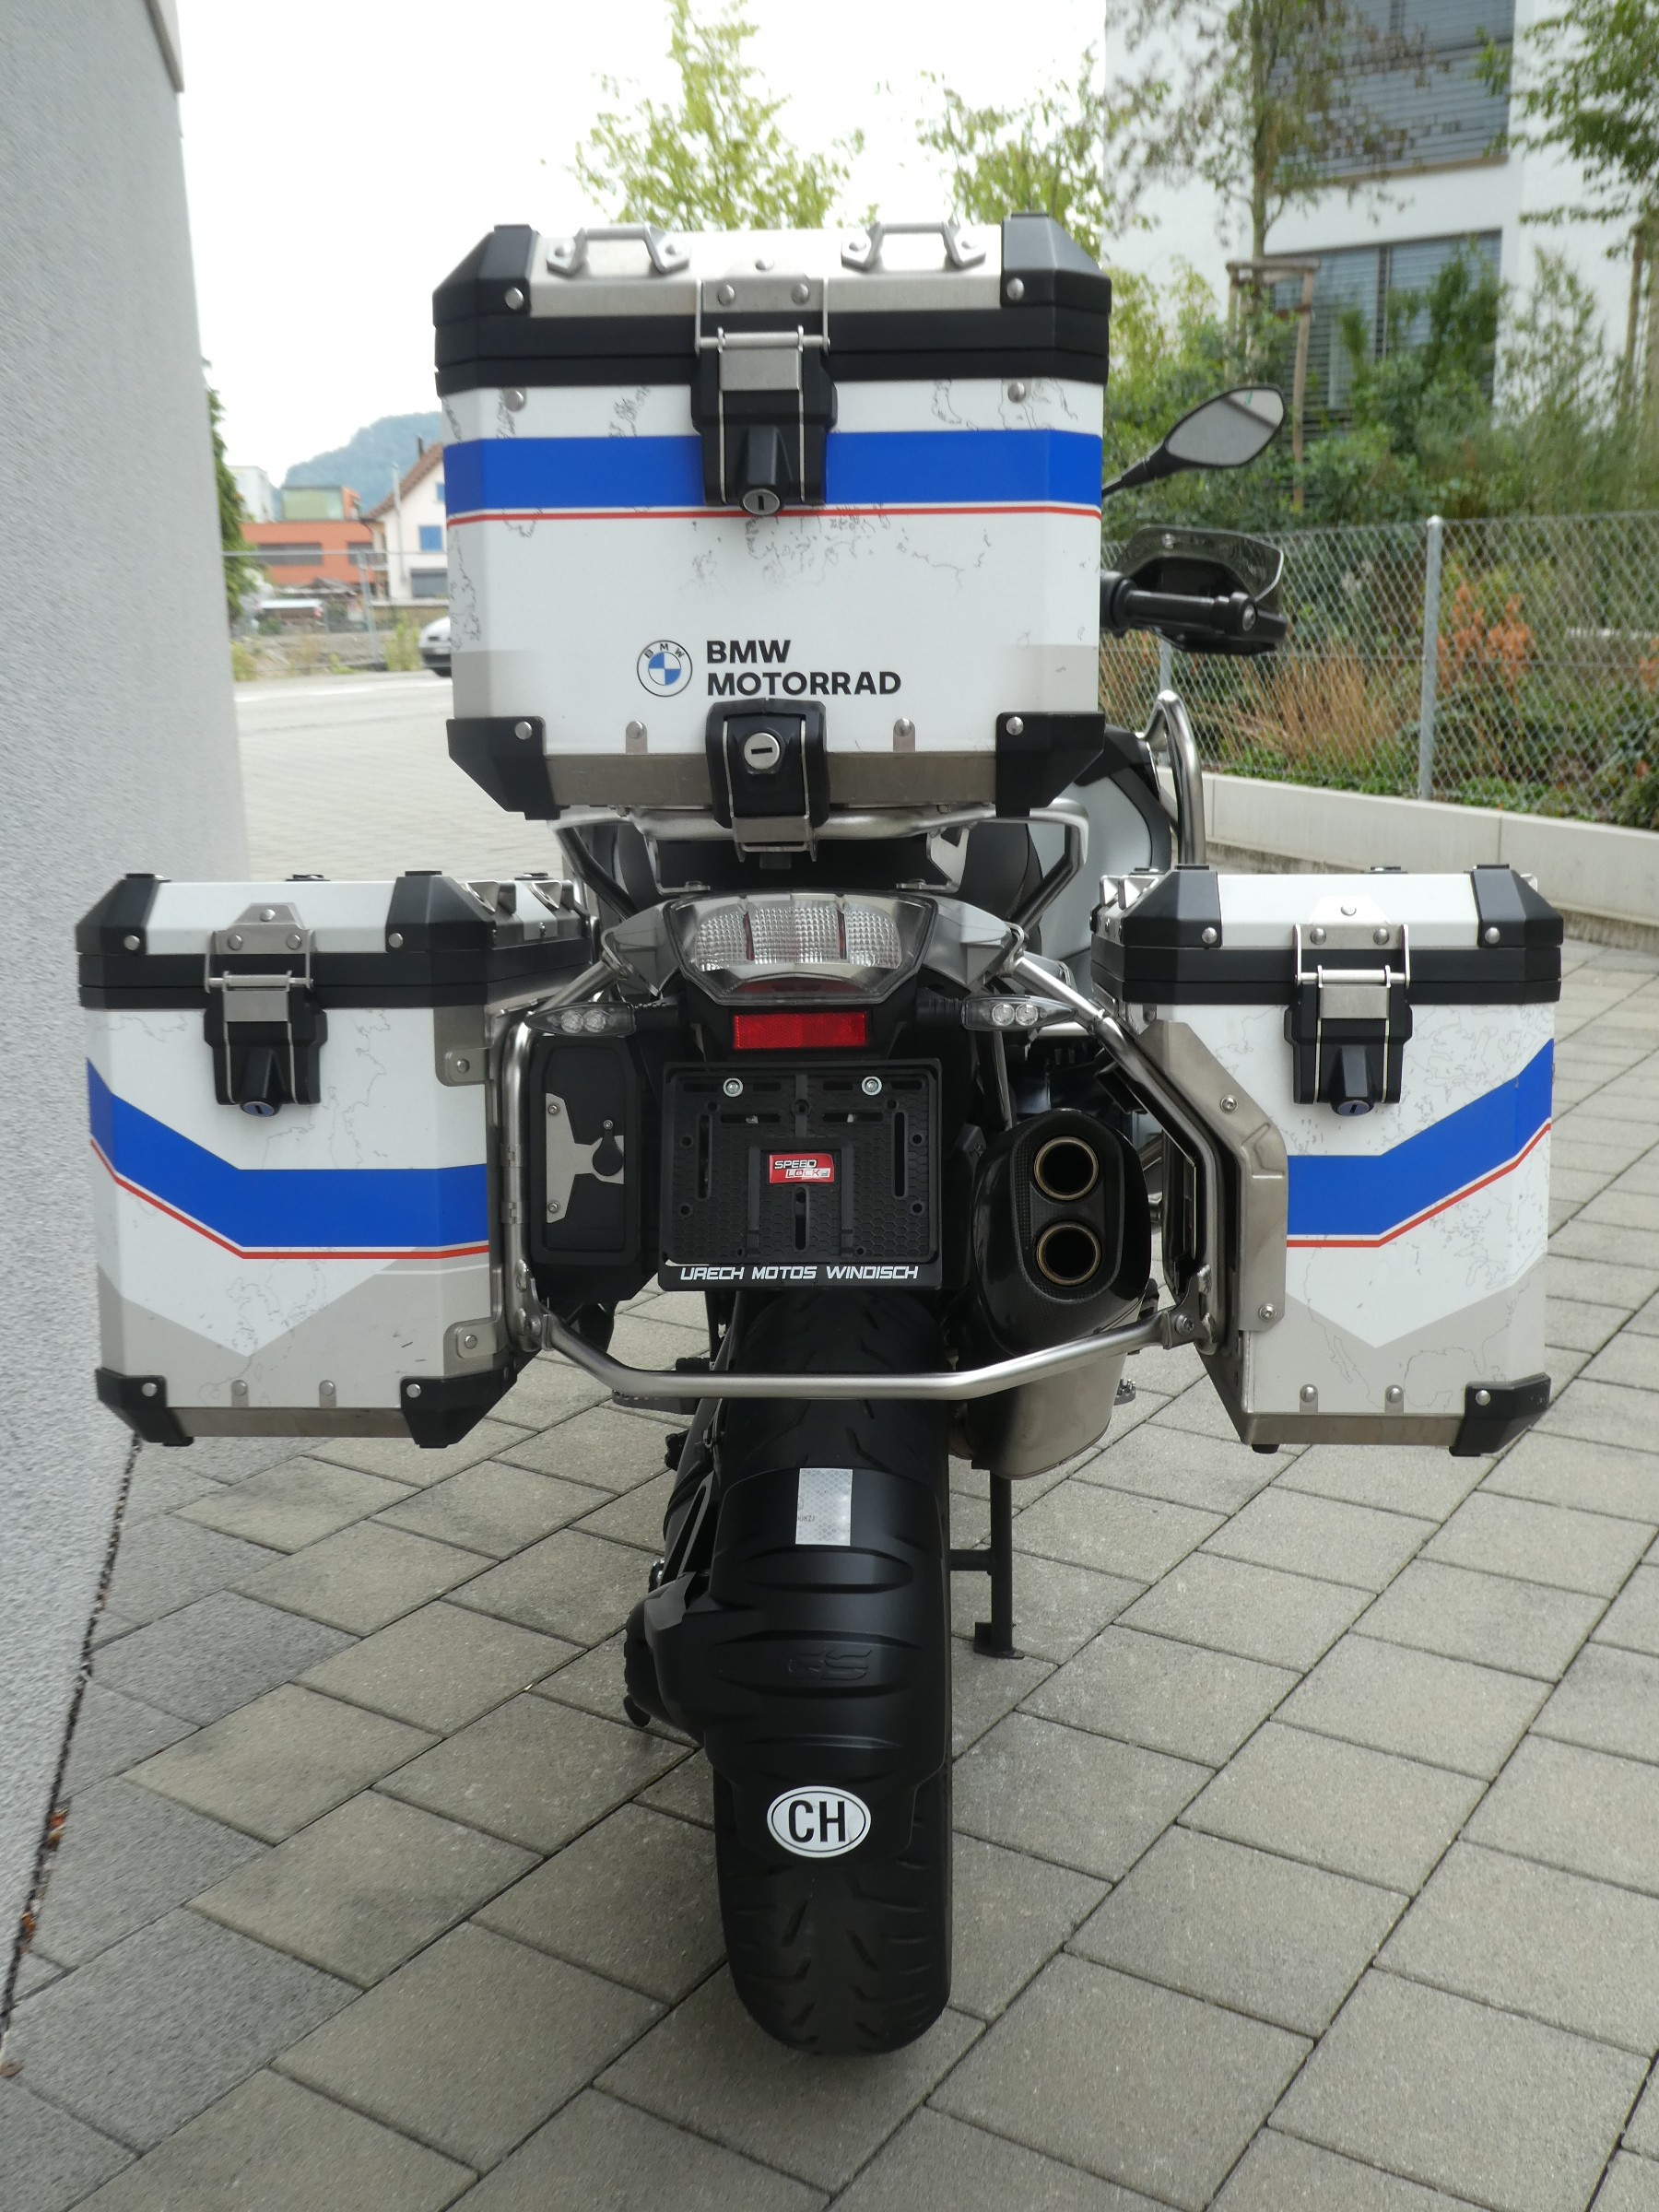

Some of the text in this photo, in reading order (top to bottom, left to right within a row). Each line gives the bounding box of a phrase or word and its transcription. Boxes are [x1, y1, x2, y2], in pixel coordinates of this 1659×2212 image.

[644, 642, 685, 659] BMW
[706, 640, 791, 664] BMW
[708, 671, 901, 696] MOTORRAD
[774, 1159, 817, 1169] SPEED
[787, 1169, 820, 1177] LOCK
[680, 1265, 919, 1280] URECH MOTOS WINDISCH
[788, 1800, 846, 1842] CH
